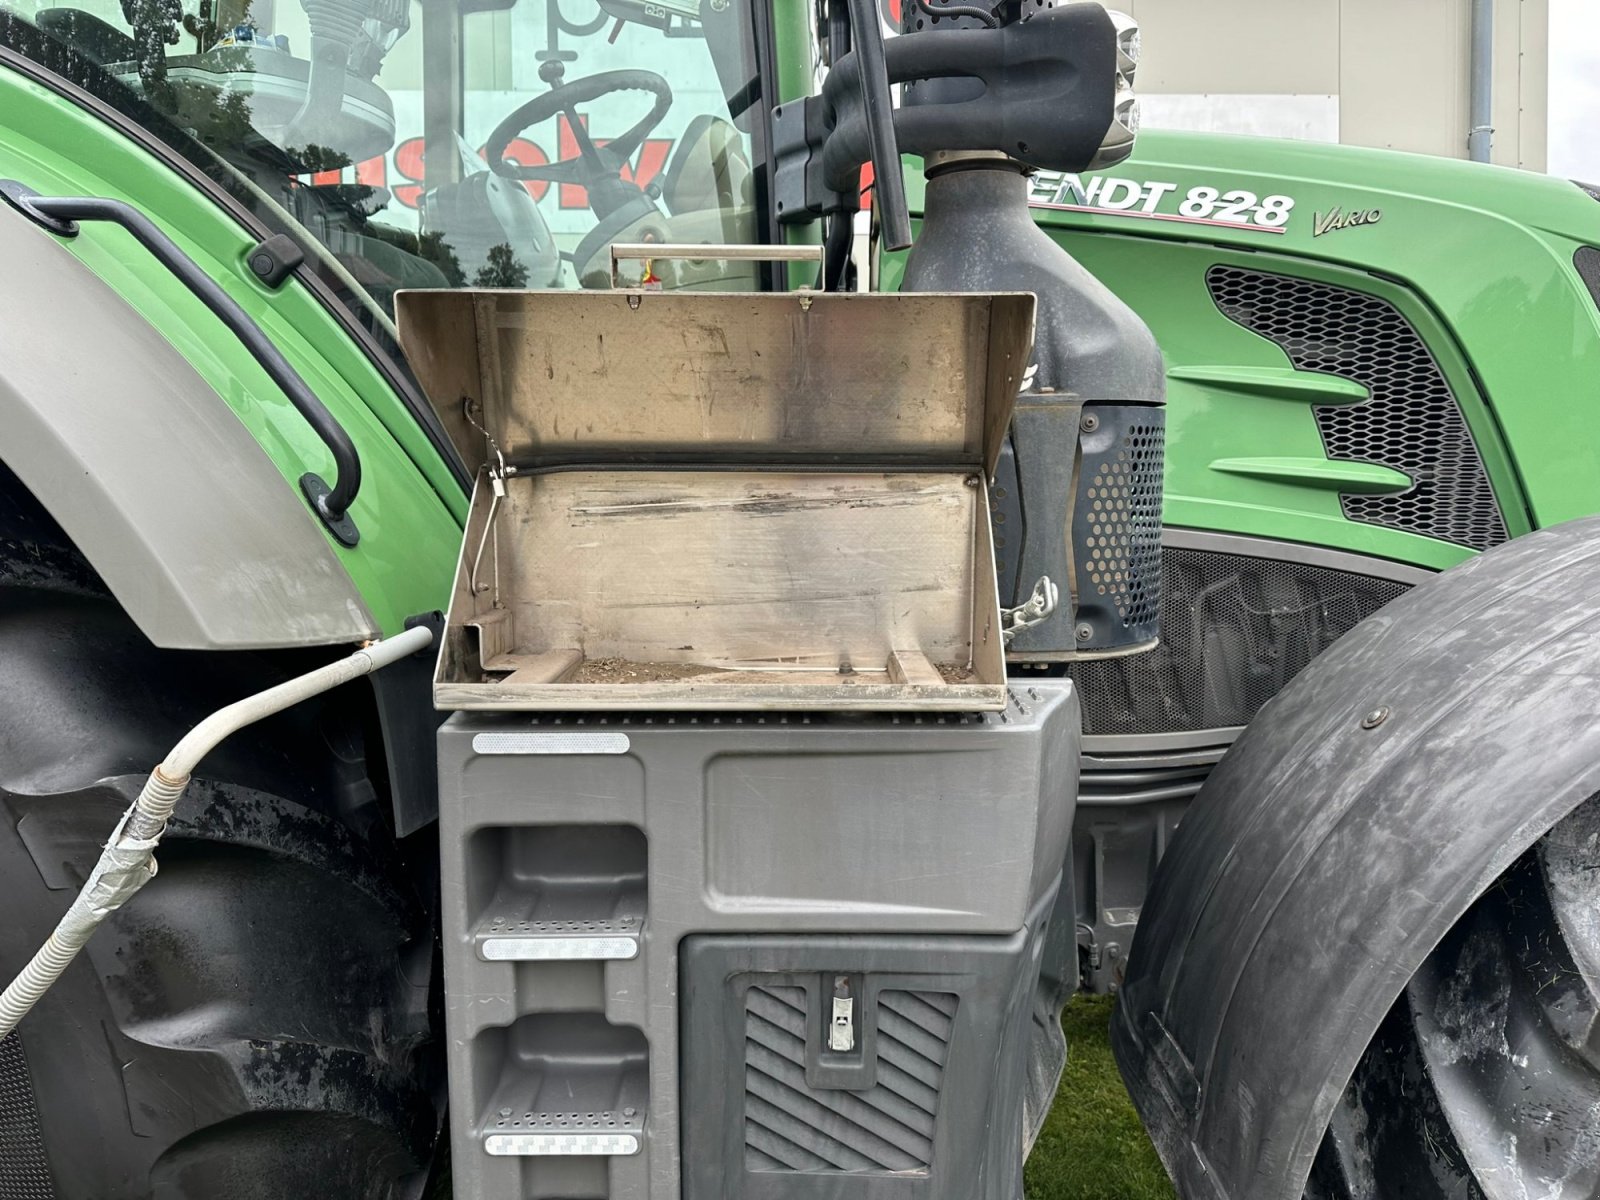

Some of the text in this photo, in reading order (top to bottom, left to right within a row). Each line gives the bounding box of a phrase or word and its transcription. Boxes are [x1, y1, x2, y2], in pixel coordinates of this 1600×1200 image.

[1027, 170, 1295, 226] ENDT 828
[1313, 206, 1382, 237] VARIO
